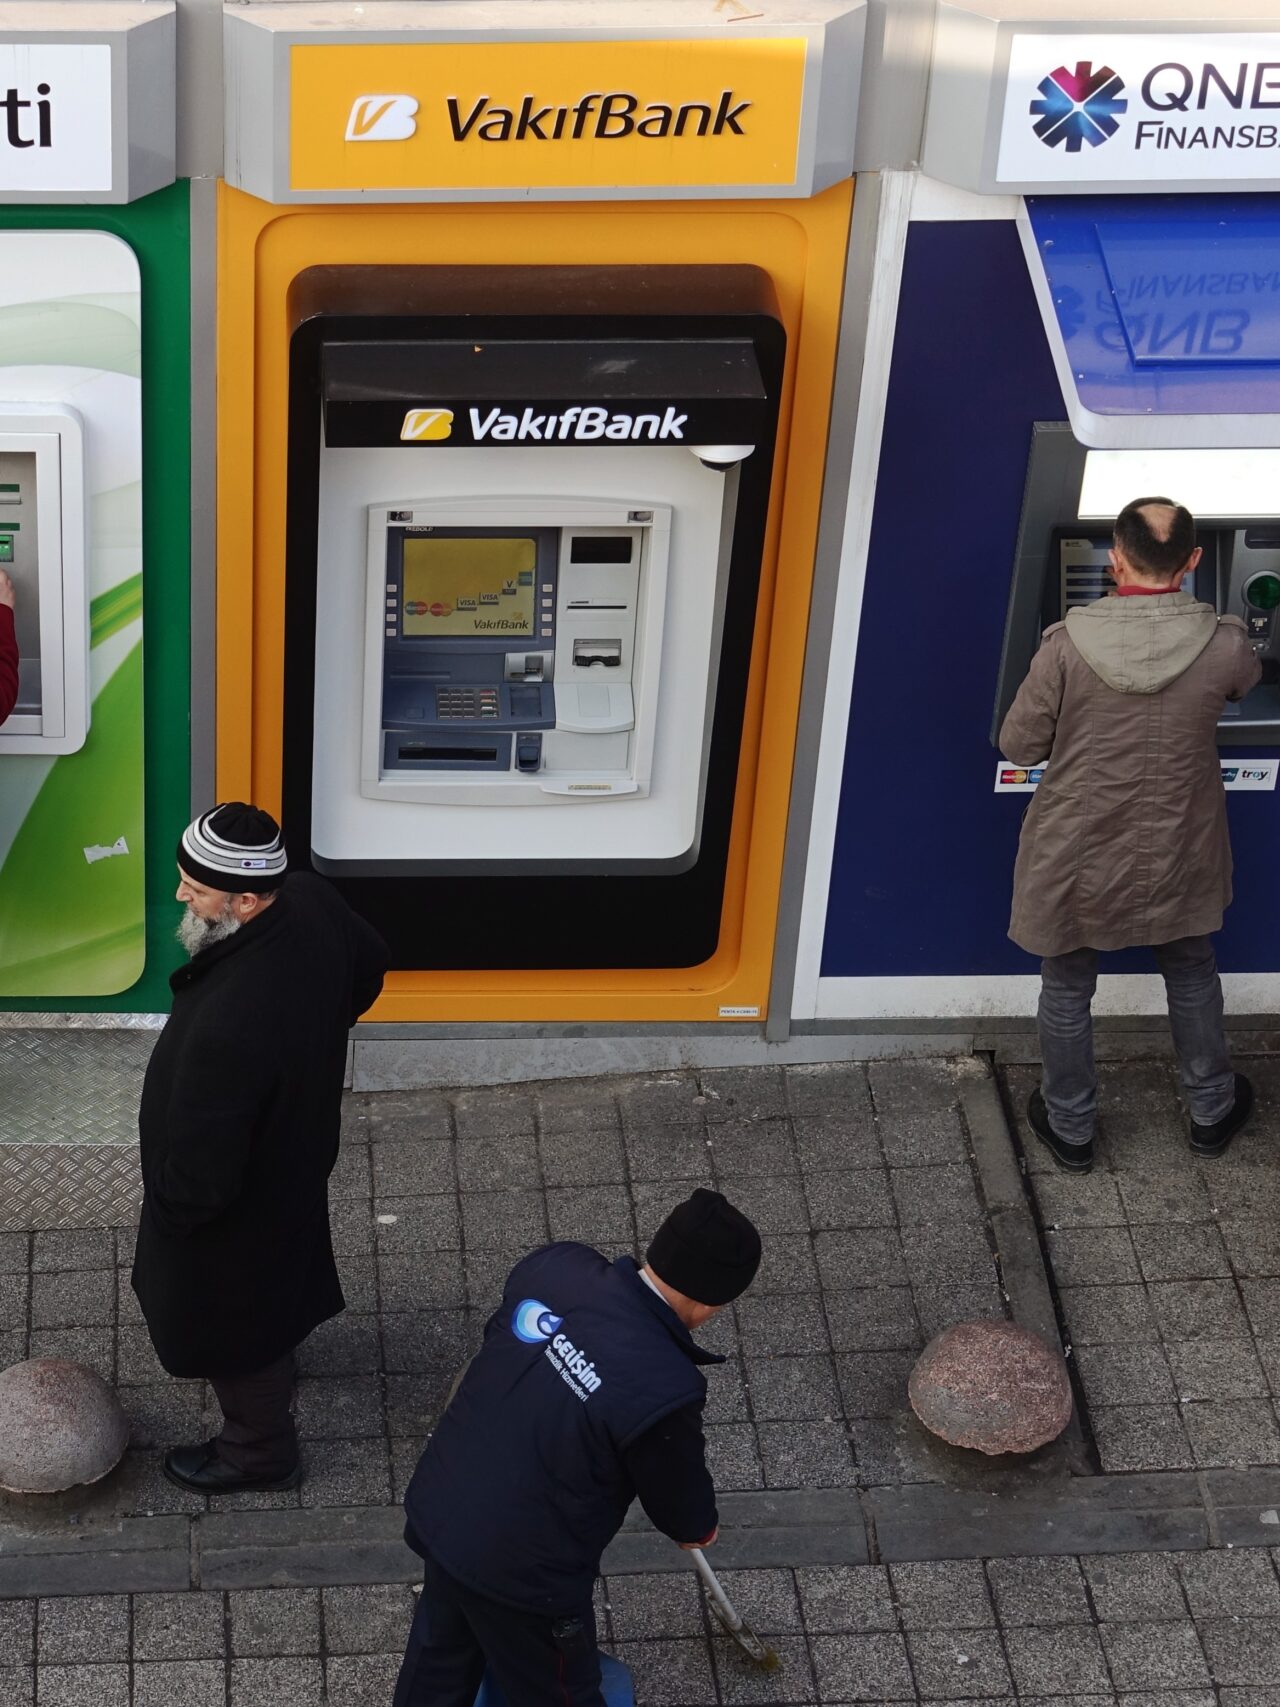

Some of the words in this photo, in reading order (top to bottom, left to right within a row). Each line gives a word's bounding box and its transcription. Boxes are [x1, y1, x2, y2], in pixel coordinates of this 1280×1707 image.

[446, 90, 751, 142] VakıfBank
[1134, 120, 1280, 150] FINANSB
[469, 406, 688, 440] VakıfBank
[1241, 770, 1269, 781] troy
